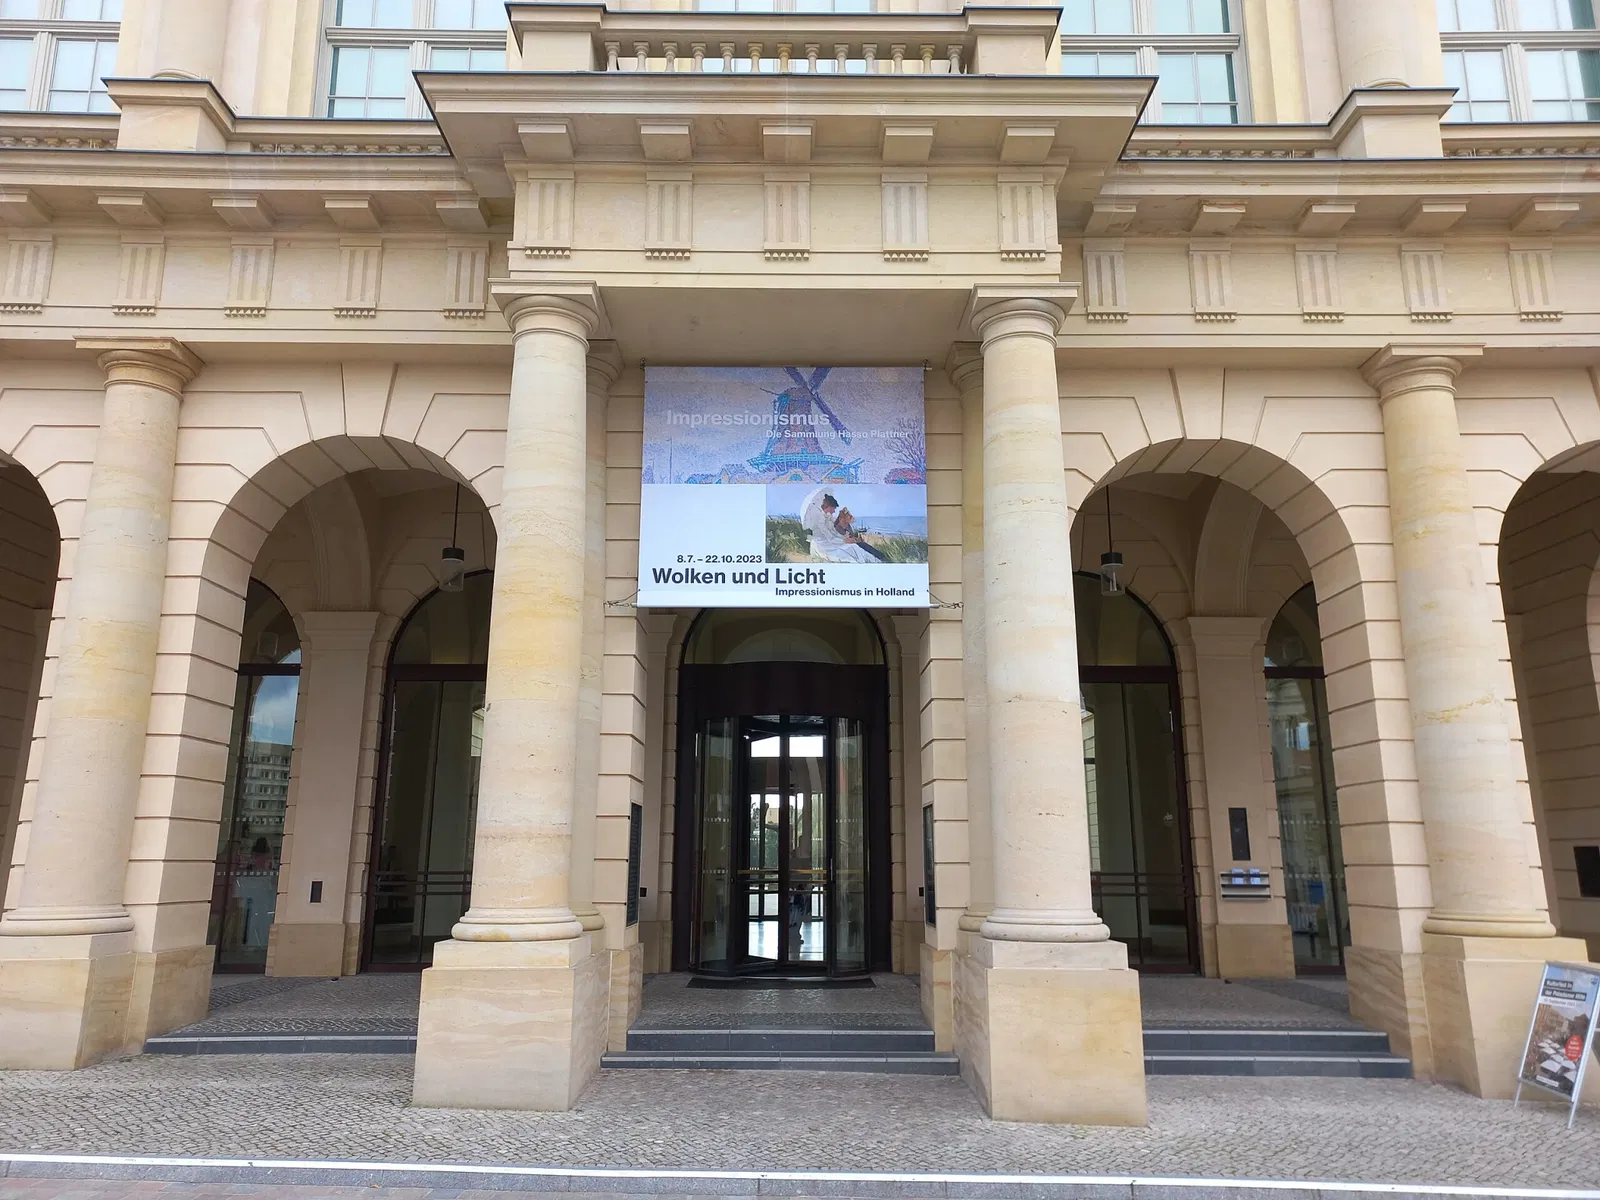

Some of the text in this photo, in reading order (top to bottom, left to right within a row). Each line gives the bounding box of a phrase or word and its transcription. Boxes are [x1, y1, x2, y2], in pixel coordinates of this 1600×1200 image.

[666, 409, 830, 428] Impressionismus
[766, 430, 909, 439] Die Sammlung Hasso Plattner
[705, 555, 762, 563] 22.10.2023
[652, 568, 826, 584] Wolken und Licht
[775, 587, 915, 597] Impressionismus in Holland
